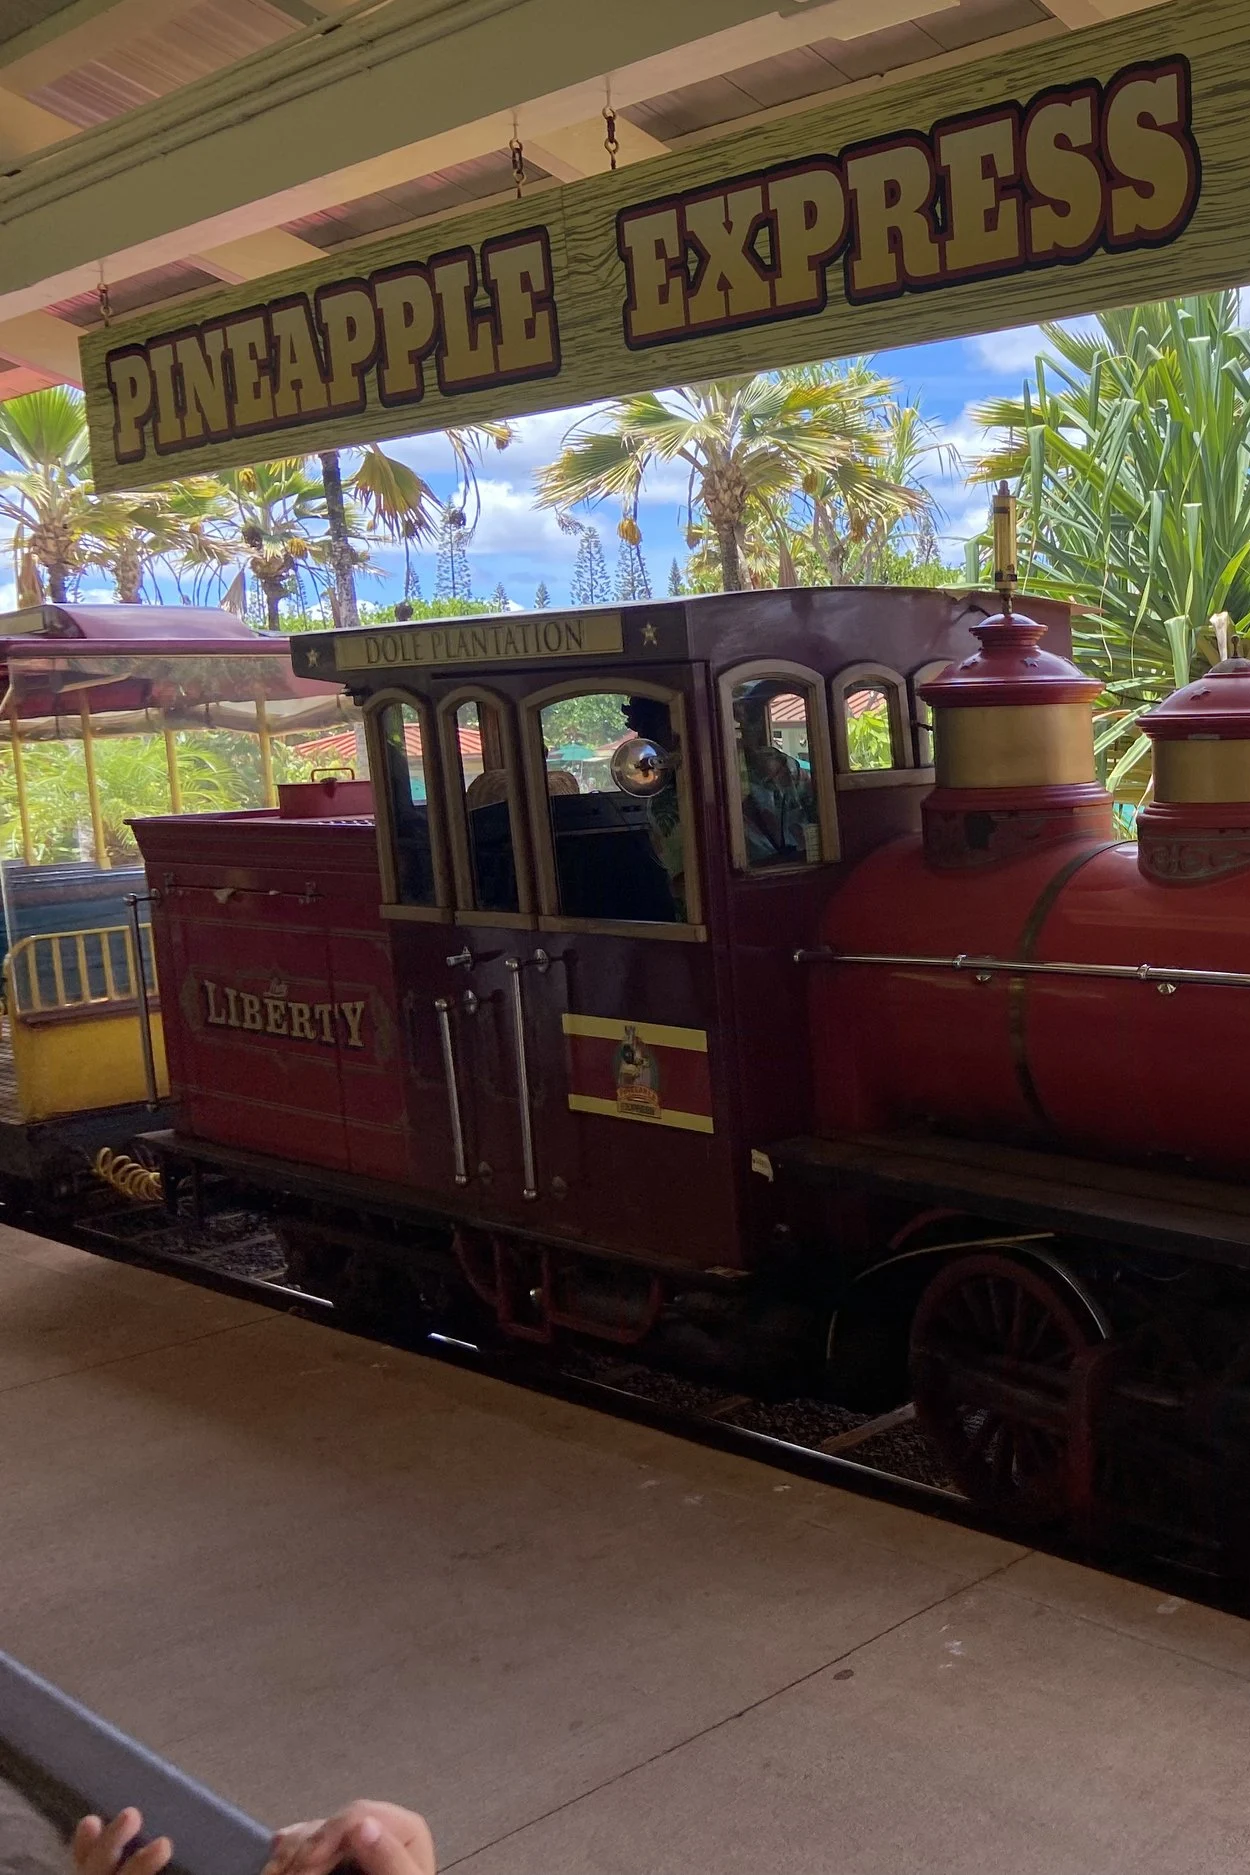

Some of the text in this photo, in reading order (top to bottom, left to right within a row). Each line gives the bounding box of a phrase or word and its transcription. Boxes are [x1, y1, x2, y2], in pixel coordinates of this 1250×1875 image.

[107, 227, 561, 462] PINEAPPLE
[618, 57, 1199, 347] EXPRESS
[365, 619, 584, 664] DOLE PLANTATION
[203, 979, 365, 1047] LIBERTY
